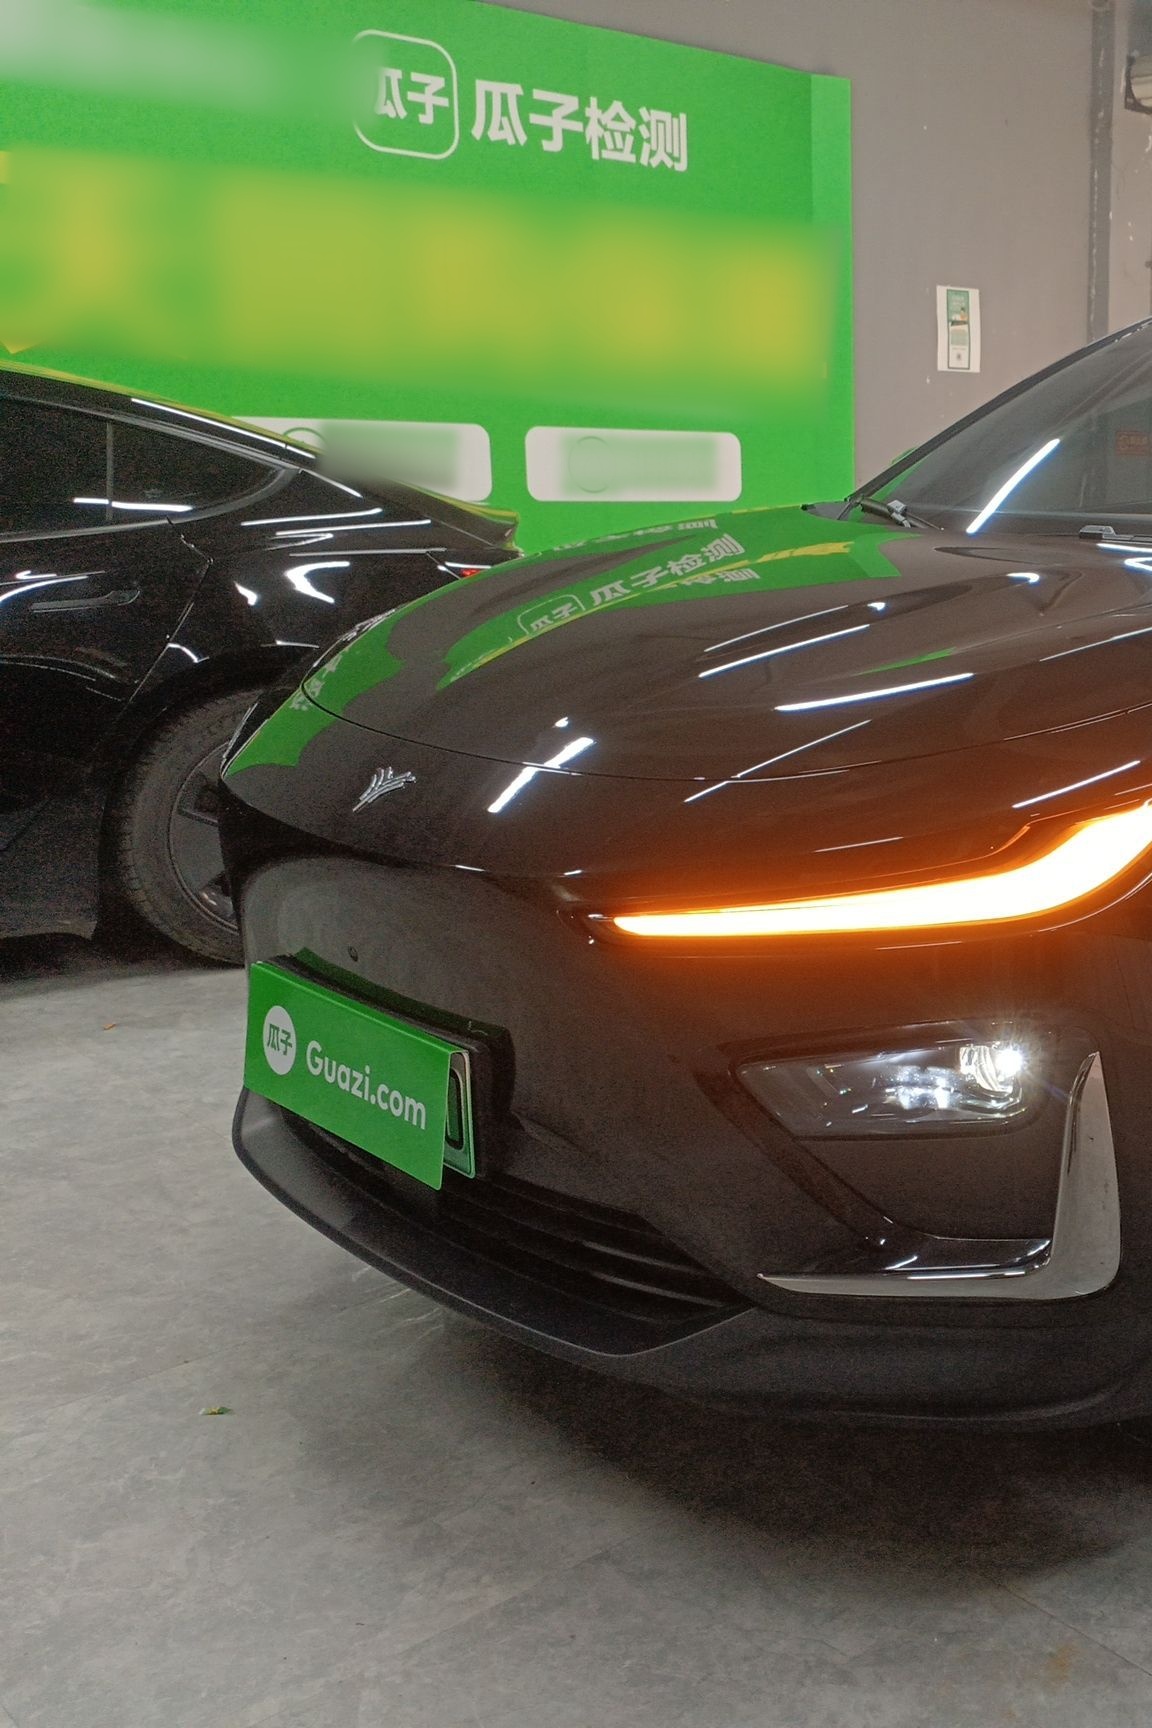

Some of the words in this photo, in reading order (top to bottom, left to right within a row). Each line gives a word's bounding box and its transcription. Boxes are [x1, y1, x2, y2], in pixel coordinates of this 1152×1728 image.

[471, 79, 688, 172] 瓜子检测
[589, 533, 745, 606] 瓜子检测
[267, 1023, 293, 1056] 瓜子
[306, 1040, 427, 1130] Guazi.com
